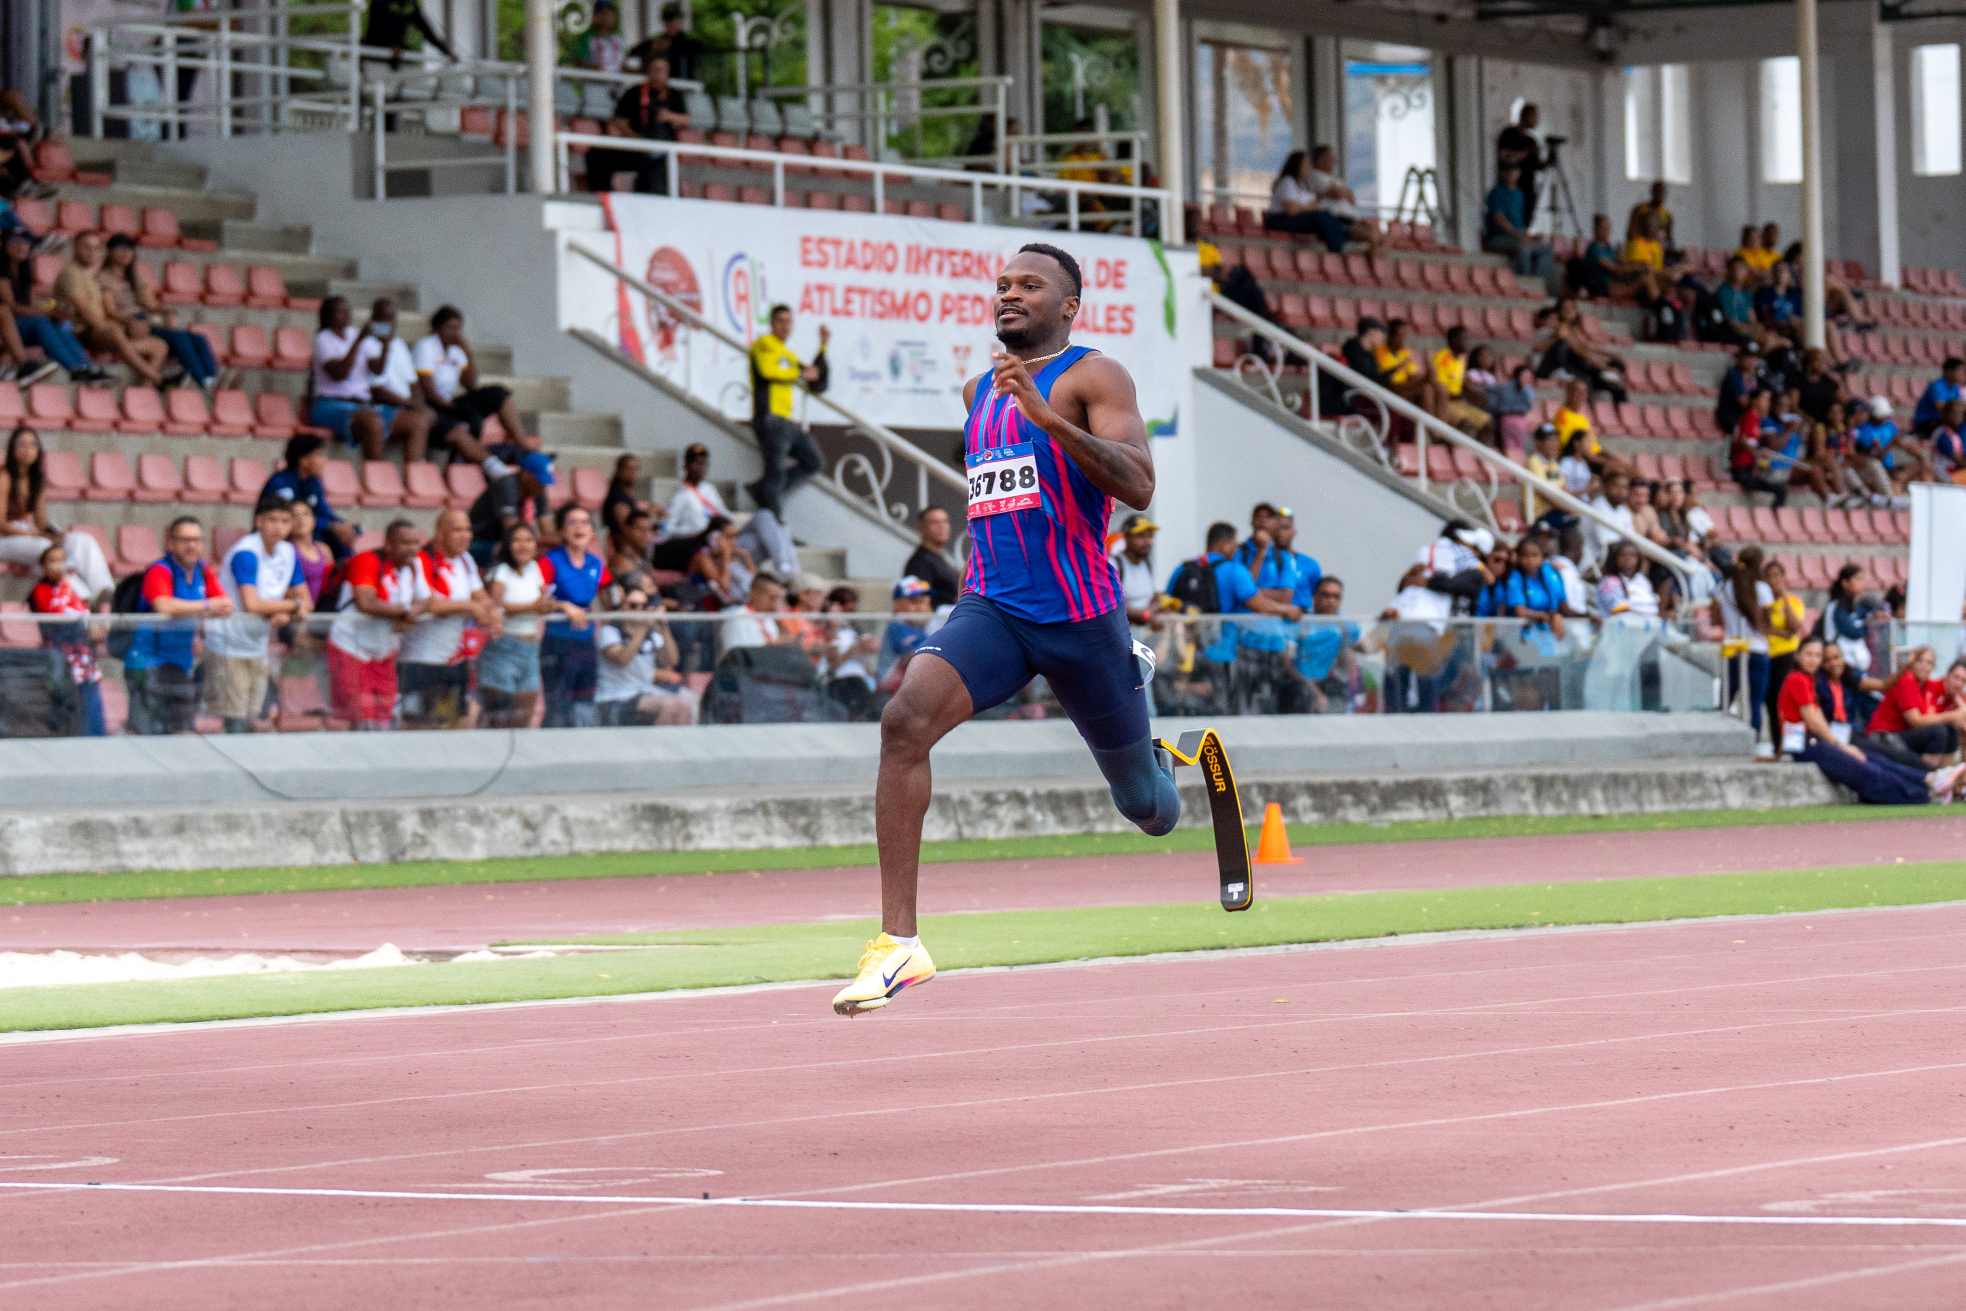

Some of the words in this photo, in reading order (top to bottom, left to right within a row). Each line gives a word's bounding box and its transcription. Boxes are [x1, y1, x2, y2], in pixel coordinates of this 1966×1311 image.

[800, 235, 899, 273] ESTADIO
[904, 241, 1089, 288] INTERNL
[1095, 258, 1128, 290] DE
[799, 283, 932, 322] ATLETISMO
[1204, 745, 1227, 792] ÖSSUR
